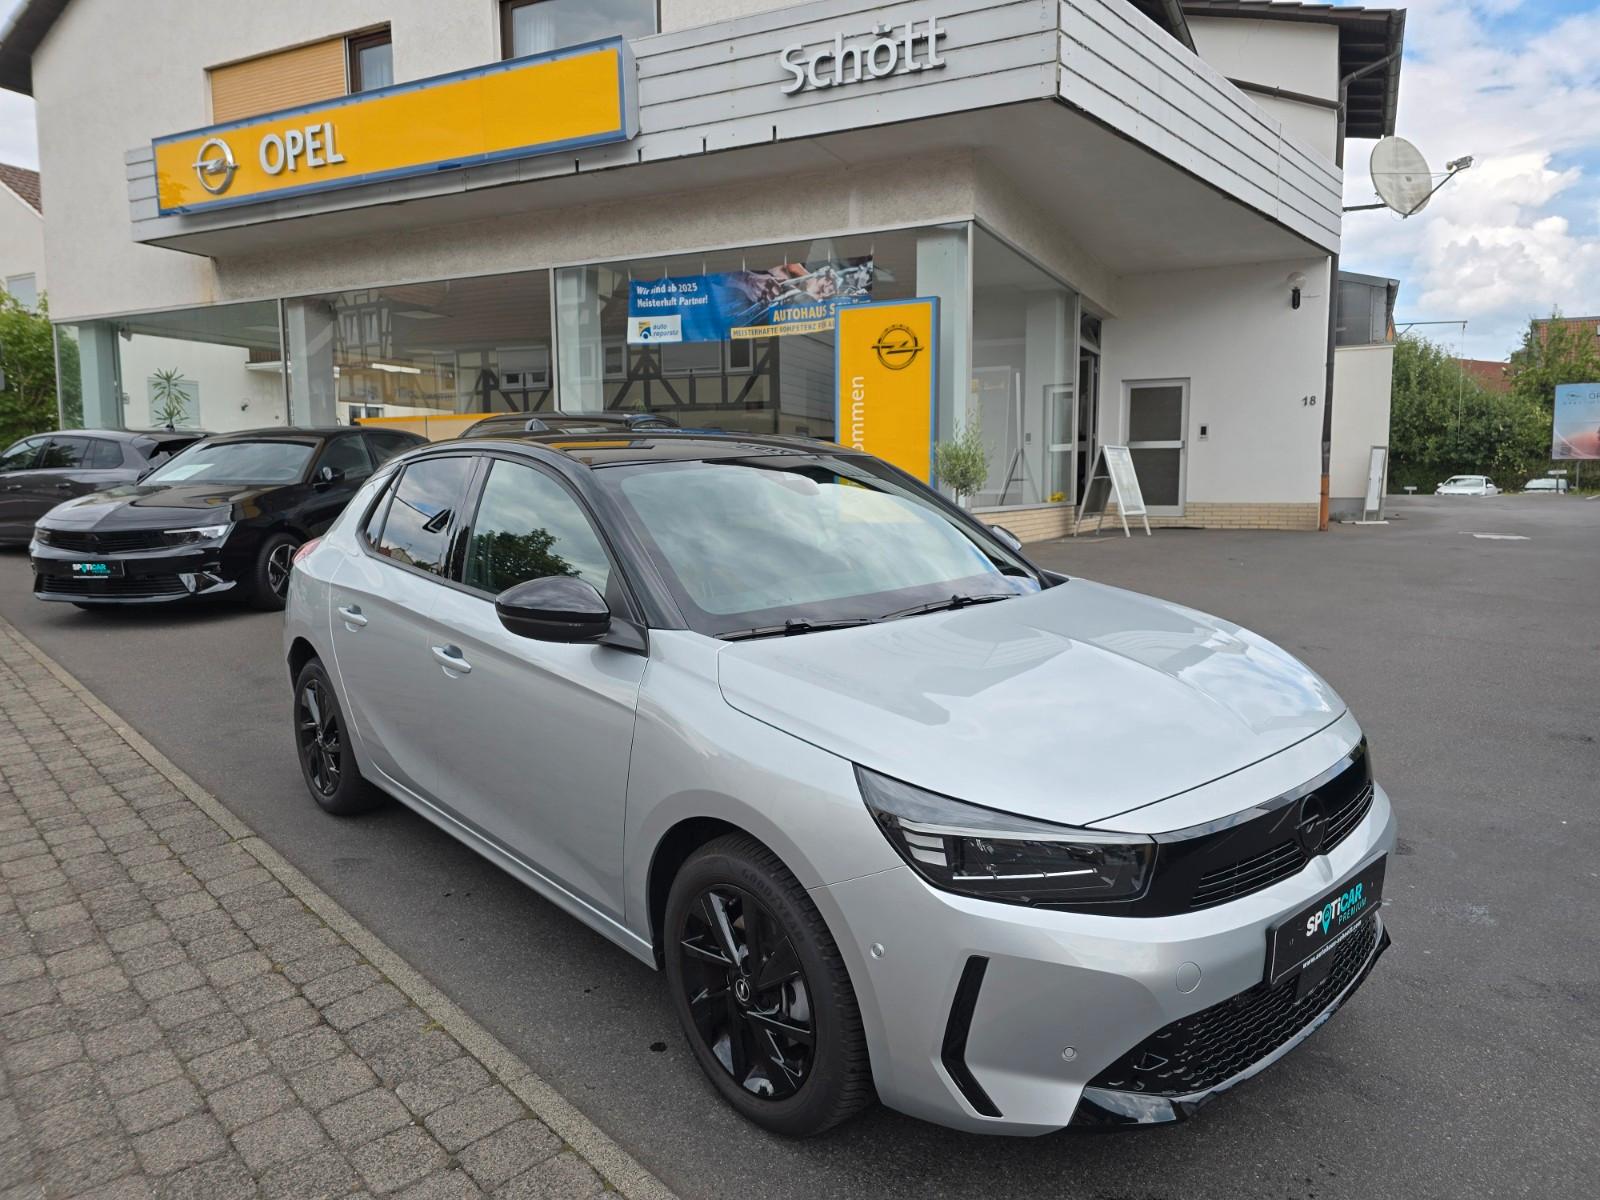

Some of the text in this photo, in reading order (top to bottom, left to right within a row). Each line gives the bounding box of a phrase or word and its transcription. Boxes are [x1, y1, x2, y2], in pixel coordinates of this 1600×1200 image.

[780, 16, 946, 95] Schött
[259, 122, 345, 175] OPEL
[636, 286, 650, 295] Wir
[678, 283, 698, 292] 2025
[679, 294, 708, 306] Partner!
[773, 304, 827, 322] AUTOHAUS
[732, 325, 778, 337] MEISTERHAFTE
[1301, 395, 1316, 407] 18
[1338, 897, 1367, 925] PREMIUM
